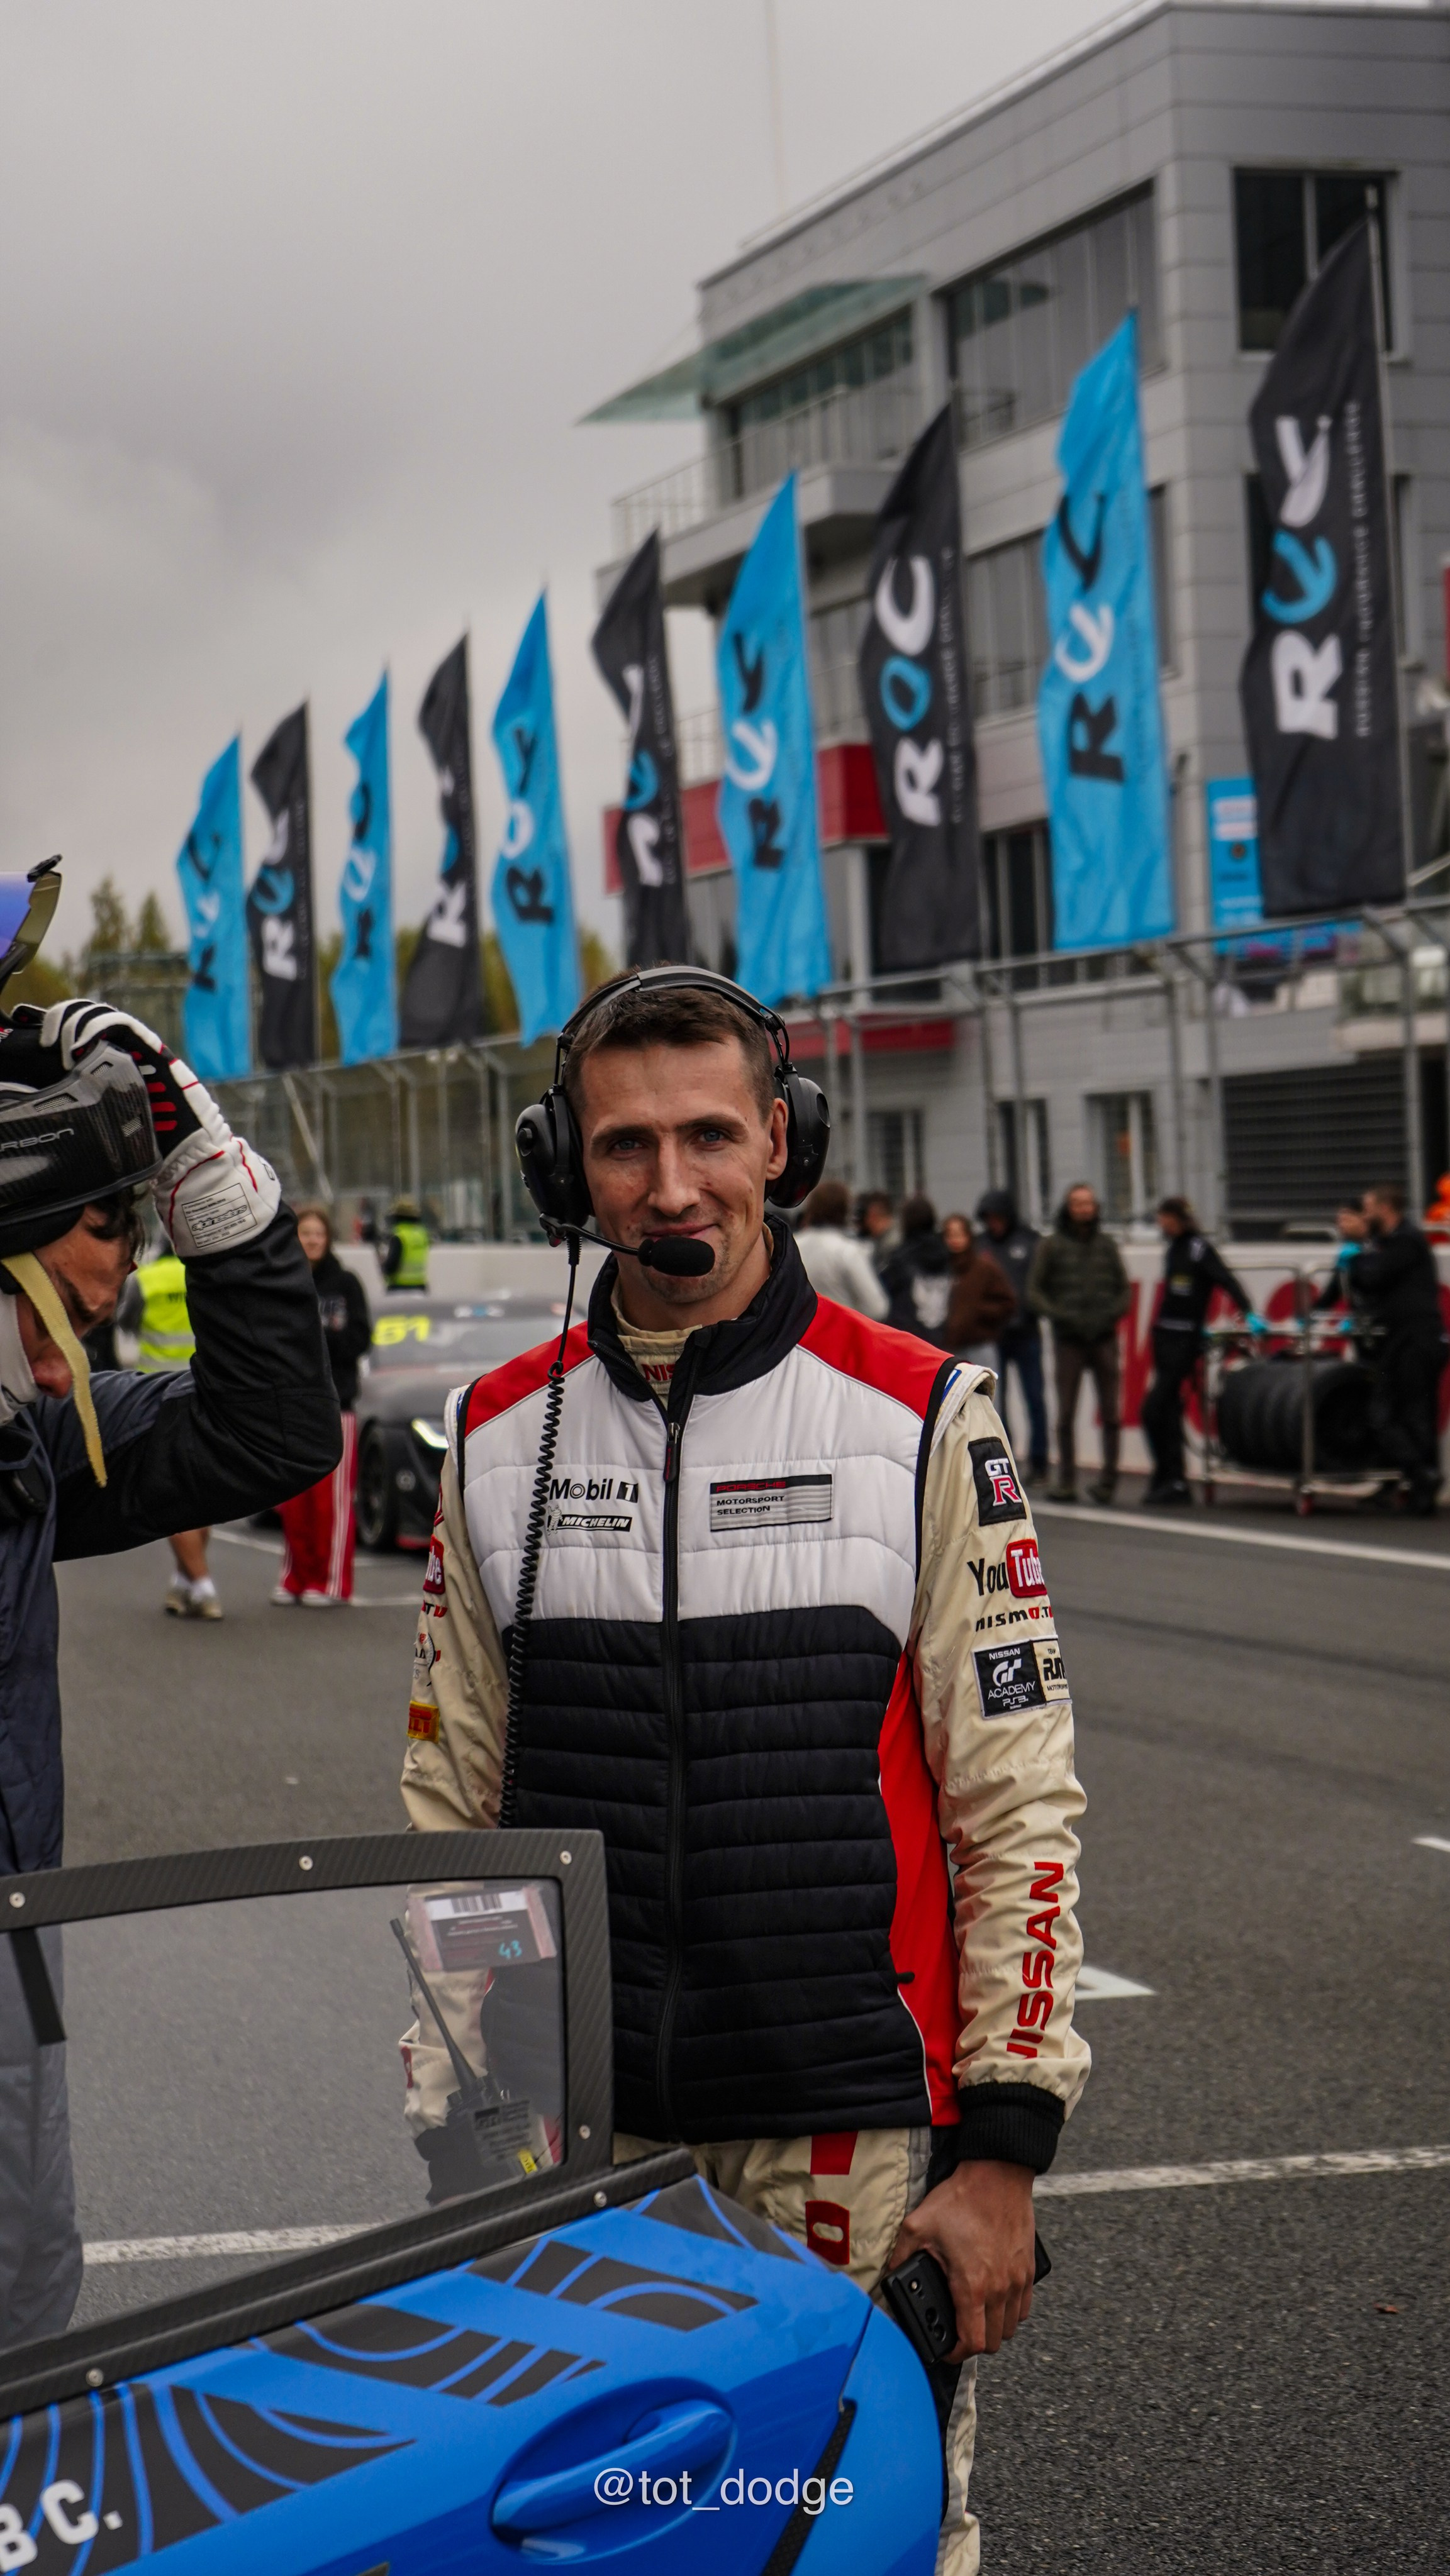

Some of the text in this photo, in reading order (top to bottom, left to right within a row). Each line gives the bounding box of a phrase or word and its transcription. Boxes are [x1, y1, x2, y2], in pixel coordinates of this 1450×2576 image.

[984, 1458, 1010, 1477] GT
[549, 1479, 613, 1500] Mobil
[716, 1481, 786, 1492] PORSCHE
[991, 1474, 1023, 1507] R
[717, 1496, 784, 1506] MOTORSPORT
[717, 1506, 771, 1516] SELECTION
[562, 1517, 630, 1528] MICHELIN
[989, 1648, 1020, 1660] NISSAN
[988, 1681, 1035, 1700] ACADEMY
